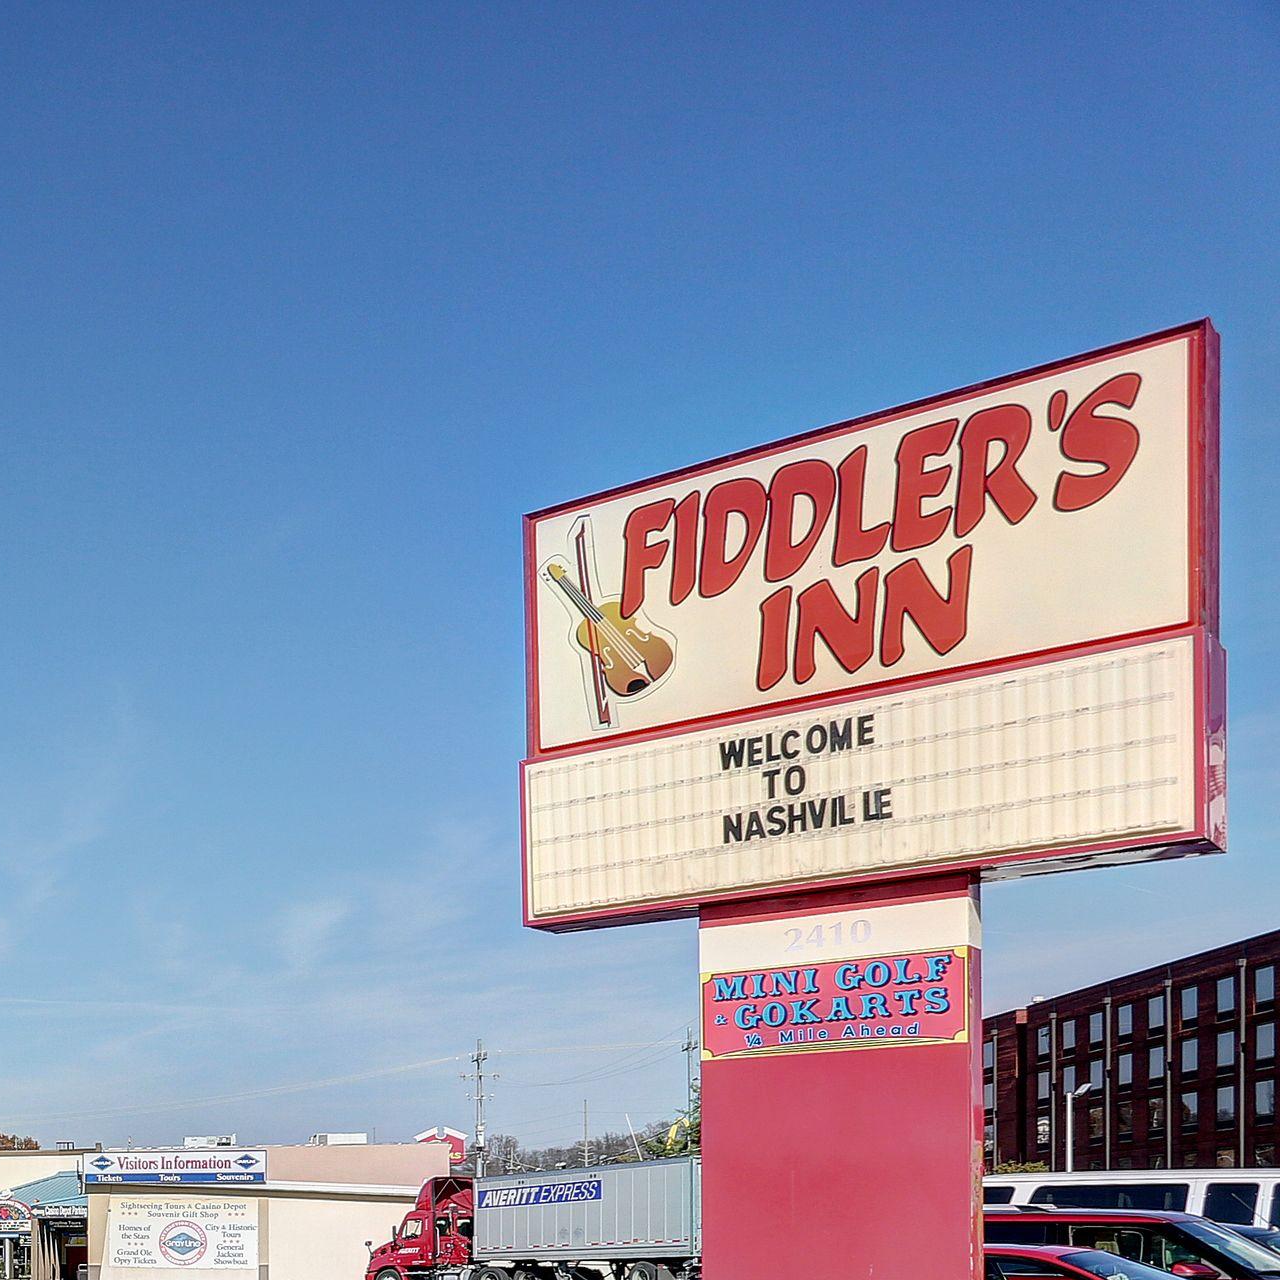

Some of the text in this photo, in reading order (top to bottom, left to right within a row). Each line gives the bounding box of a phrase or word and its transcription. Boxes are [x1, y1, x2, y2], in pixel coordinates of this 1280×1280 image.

[619, 372, 1142, 618] FIDDLER'S
[757, 543, 973, 691] INN
[719, 714, 875, 771] WELCOME
[762, 765, 806, 799] TO
[783, 919, 873, 952] 2410
[712, 955, 952, 1002] MINI GOLF
[714, 987, 951, 1031] & GOKARTS
[780, 1030, 829, 1045] Mile
[842, 1022, 920, 1038] Ahead
[117, 1155, 231, 1170] Visitors Information
[96, 1173, 254, 1182] Tickets Tours Souvenirs
[539, 1181, 598, 1203] EXPRESS
[120, 1202, 162, 1210] Sightseeing
[164, 1202, 185, 1210] Tours
[194, 1202, 221, 1210] Casino
[223, 1203, 247, 1211] Depot
[200, 1211, 219, 1219] Shop
[133, 1232, 150, 1240] Stars
[205, 1224, 220, 1233] City
[114, 1257, 130, 1265] Opry
[132, 1257, 157, 1265] Tickets
